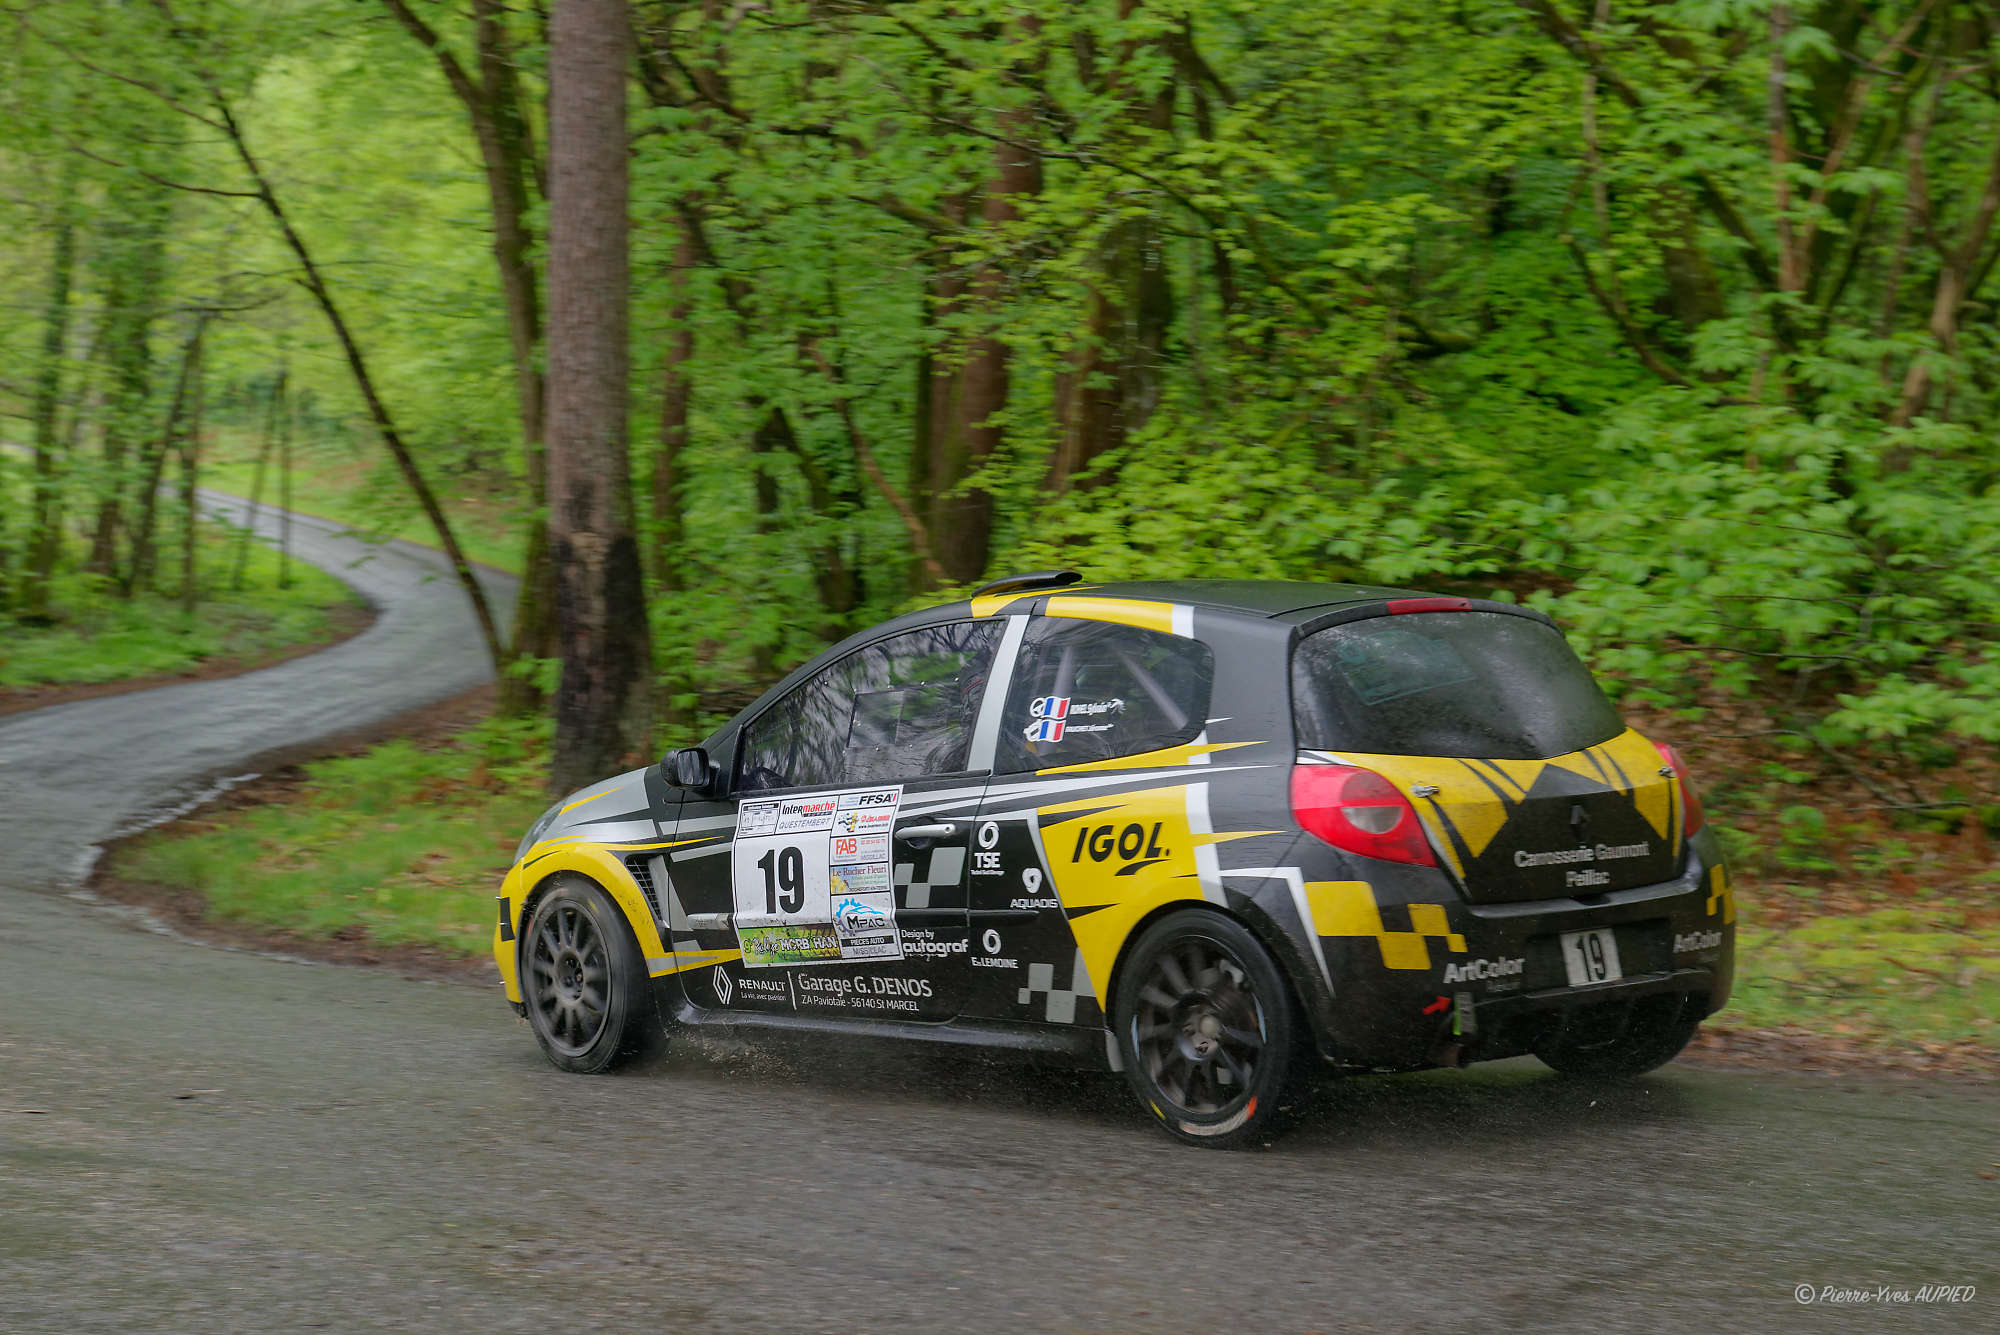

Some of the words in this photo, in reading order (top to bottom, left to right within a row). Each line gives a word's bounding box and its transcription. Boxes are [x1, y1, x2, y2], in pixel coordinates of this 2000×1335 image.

[859, 794, 891, 805] FFSA
[782, 801, 836, 816] Intermarché
[779, 818, 831, 830] QUESTEMBERT
[836, 838, 857, 855] FAB
[974, 852, 1001, 868] TSE
[1514, 845, 1595, 868] Carrosserie
[867, 864, 887, 874] Fleuri
[757, 846, 805, 914] 19
[1010, 898, 1058, 910] AQUADIS
[847, 916, 885, 929] MPAC
[870, 937, 885, 945] AUTO
[901, 929, 925, 940] Design
[925, 929, 934, 940] by
[1673, 930, 1723, 954] ArtColor
[903, 939, 968, 954] autograf
[1576, 933, 1606, 982] 19
[1442, 956, 1526, 984] ArtColor
[738, 978, 786, 992] RENAULT
[798, 974, 852, 997] Garage
[854, 976, 871, 994] G.
[872, 977, 933, 997] DENOS
[801, 995, 813, 1005] ZA
[851, 997, 876, 1008] 56140
[876, 999, 885, 1009] St
[886, 1000, 920, 1011] MARCEL
